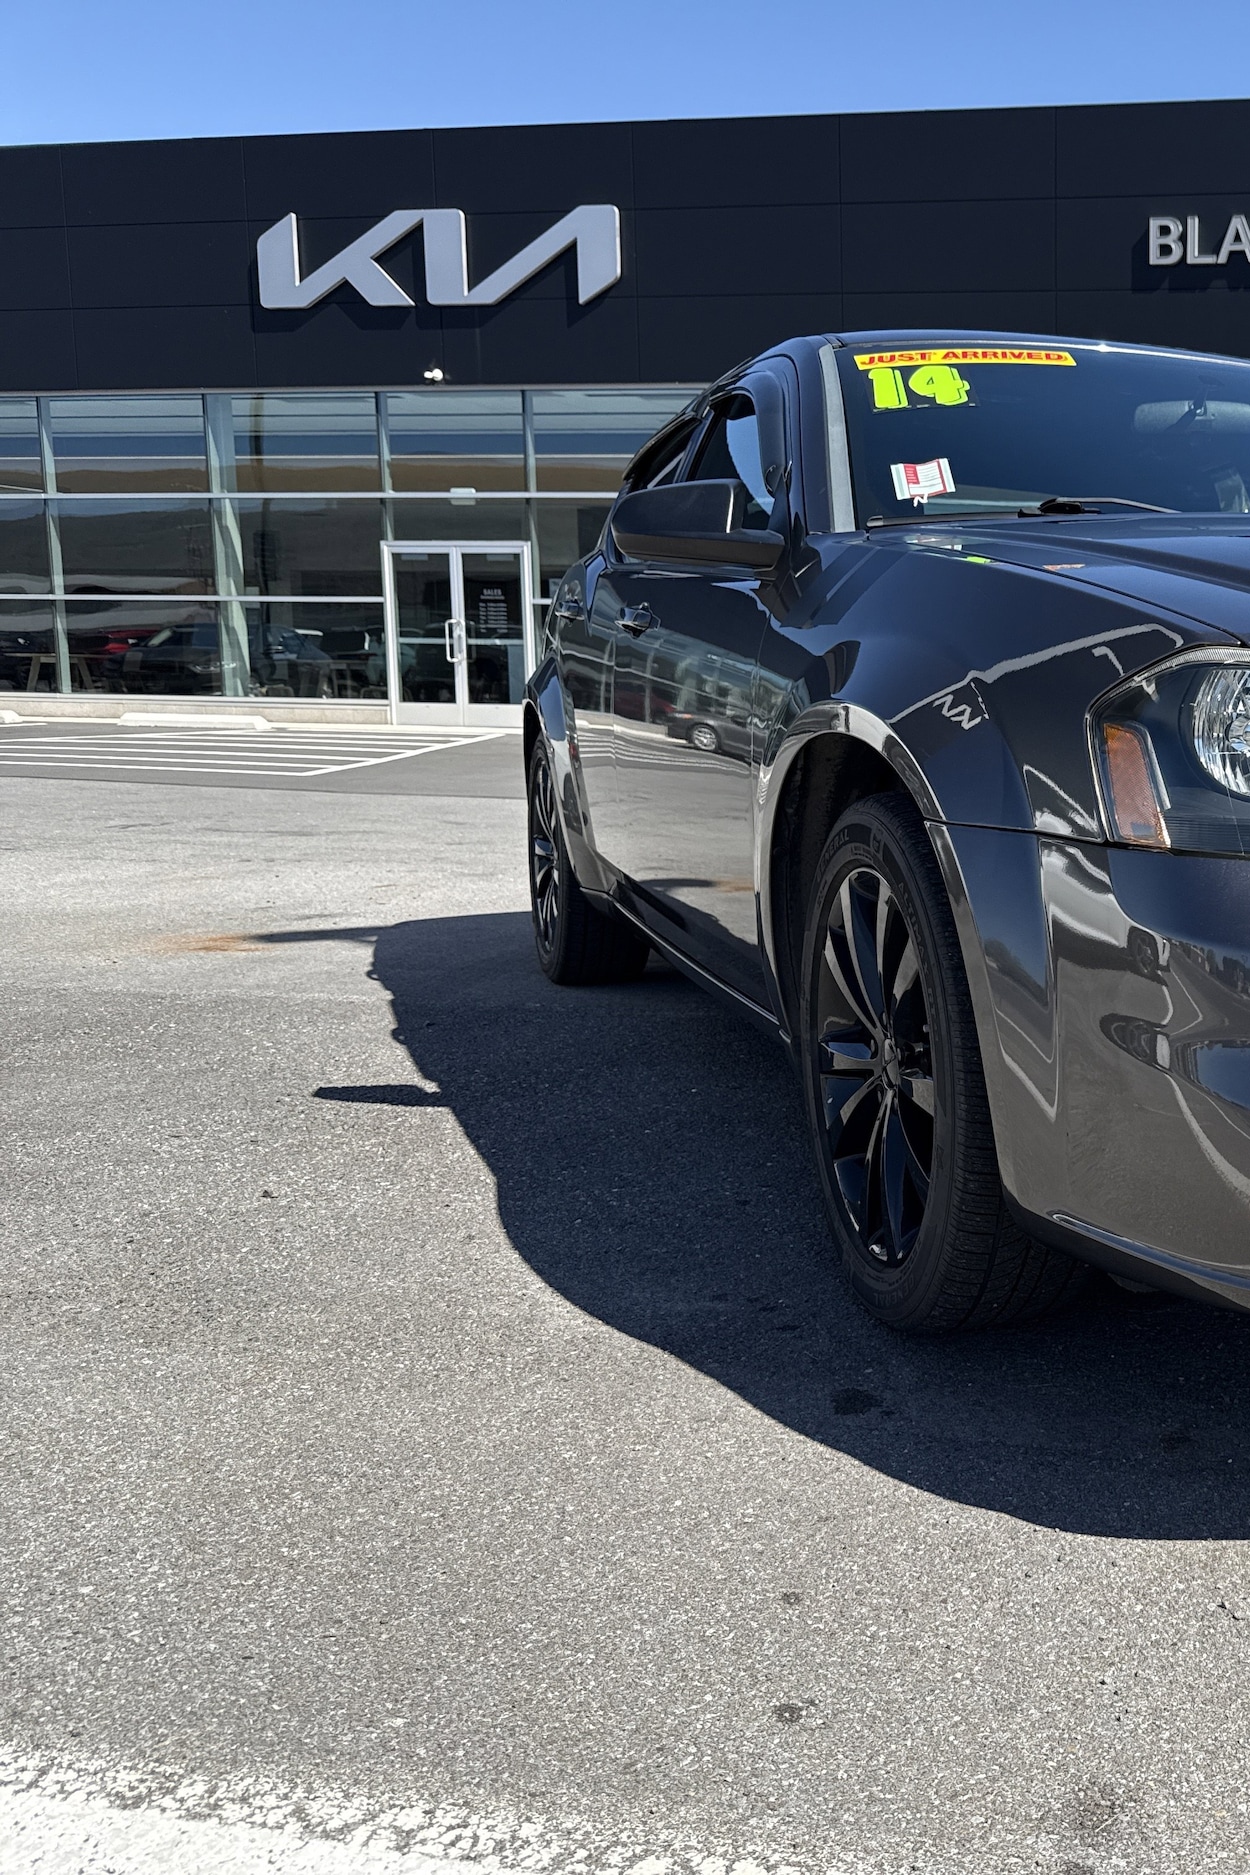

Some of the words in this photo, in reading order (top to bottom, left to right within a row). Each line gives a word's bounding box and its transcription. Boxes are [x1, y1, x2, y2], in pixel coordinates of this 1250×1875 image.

[257, 204, 622, 310] KIA
[860, 352, 928, 366] JUST
[940, 351, 1068, 362] ARRIVED
[868, 365, 970, 408] 14
